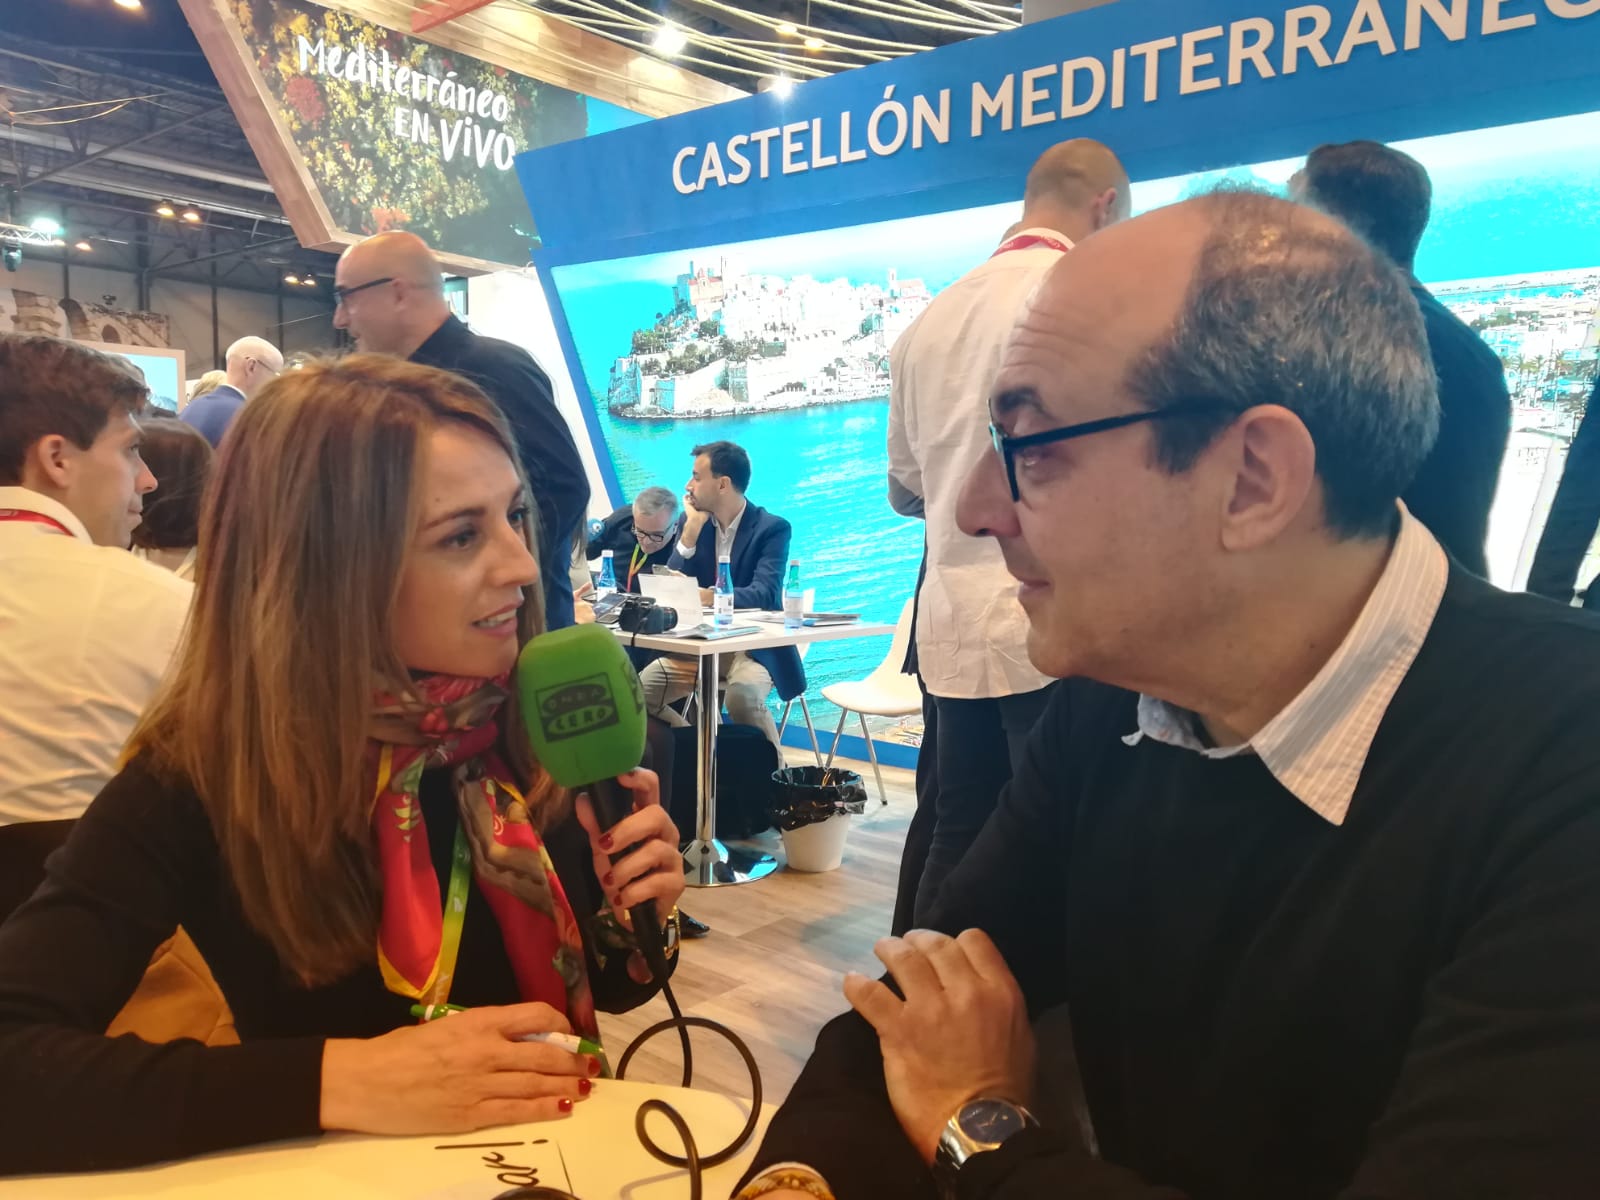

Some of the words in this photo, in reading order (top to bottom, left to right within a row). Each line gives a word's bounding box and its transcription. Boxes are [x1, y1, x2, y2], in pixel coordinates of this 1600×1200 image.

[298, 35, 509, 122] Mediterráneo
[394, 106, 430, 145] EN
[672, 84, 951, 194] CASTELLÓN
